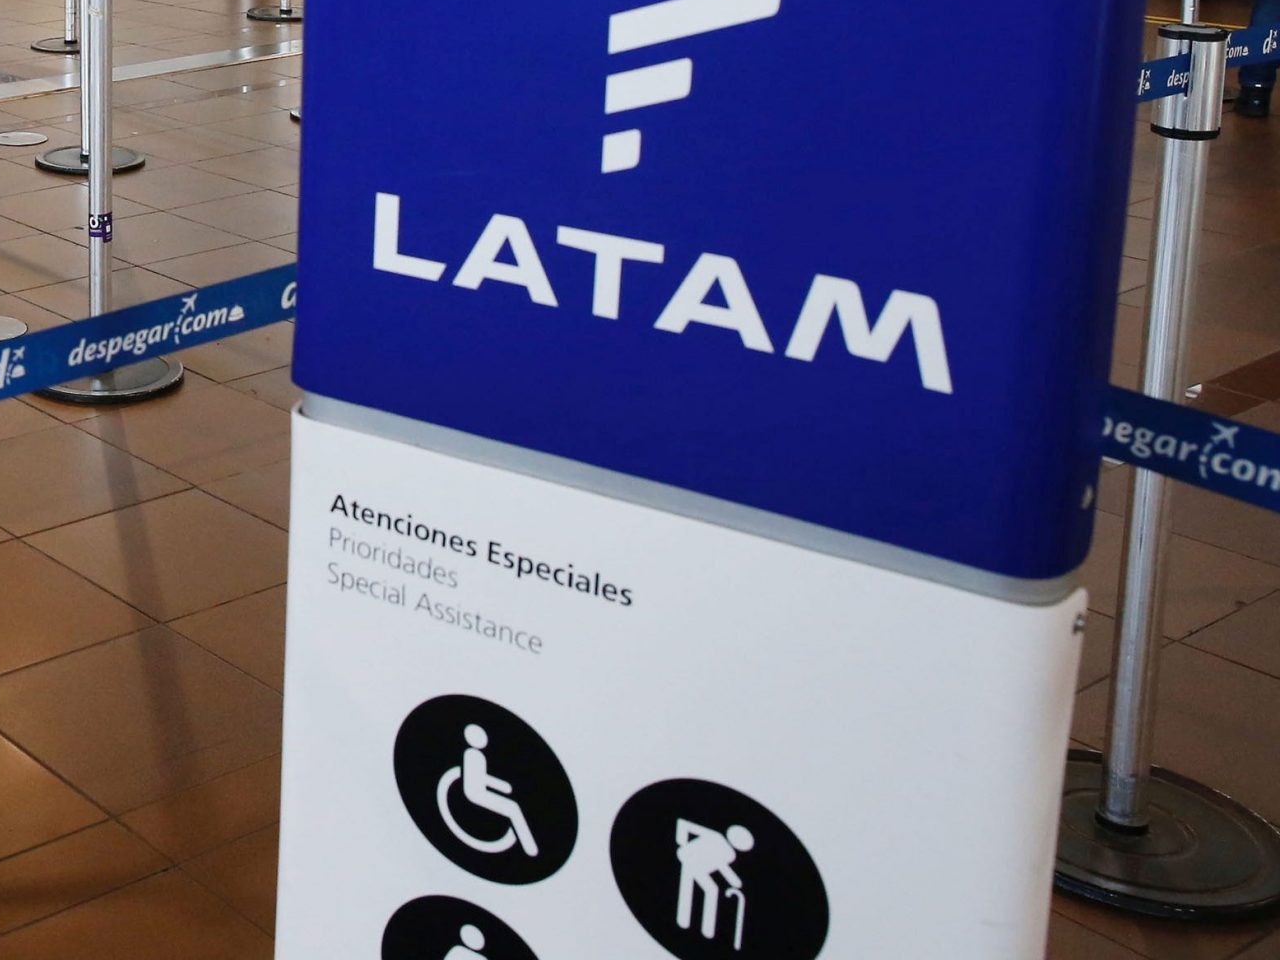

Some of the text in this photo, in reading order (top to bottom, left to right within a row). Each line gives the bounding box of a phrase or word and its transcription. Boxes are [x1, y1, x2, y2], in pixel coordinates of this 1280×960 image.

[373, 192, 952, 394] LATAM
[330, 494, 633, 608] Atenciones Especiales
[330, 526, 458, 589] Prioridades
[327, 561, 543, 655] Special Assistance
